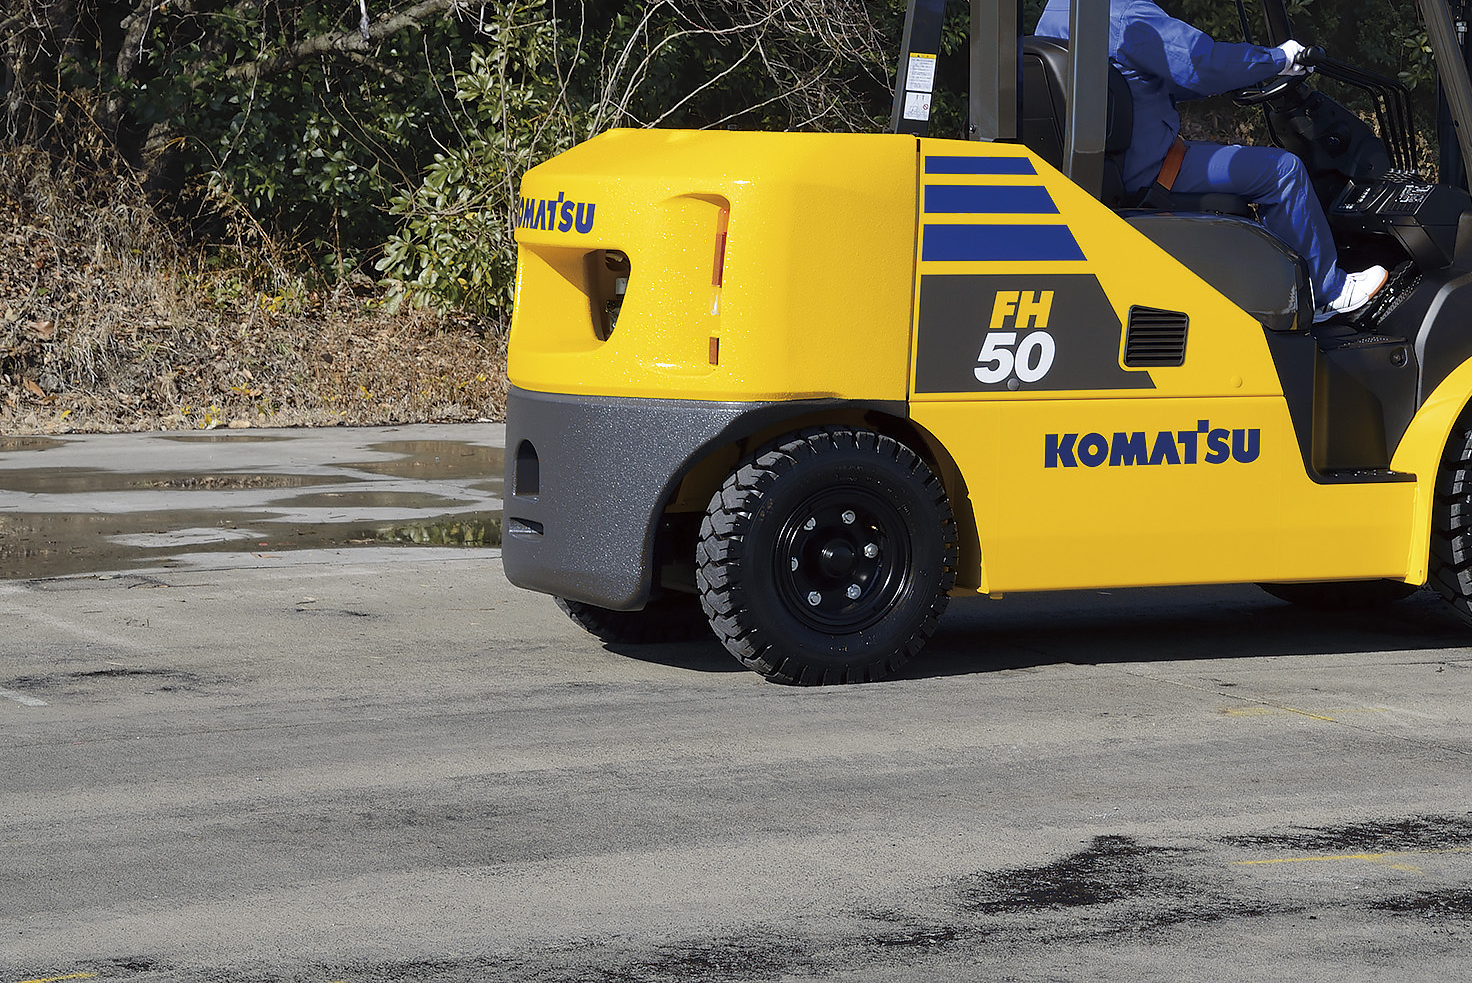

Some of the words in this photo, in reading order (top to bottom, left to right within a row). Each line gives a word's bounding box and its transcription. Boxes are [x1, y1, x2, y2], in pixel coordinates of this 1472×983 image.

[517, 191, 596, 234] OMATSU
[989, 290, 1055, 329] FH
[973, 331, 1056, 384] 50
[1044, 419, 1261, 469] KOMATSU
